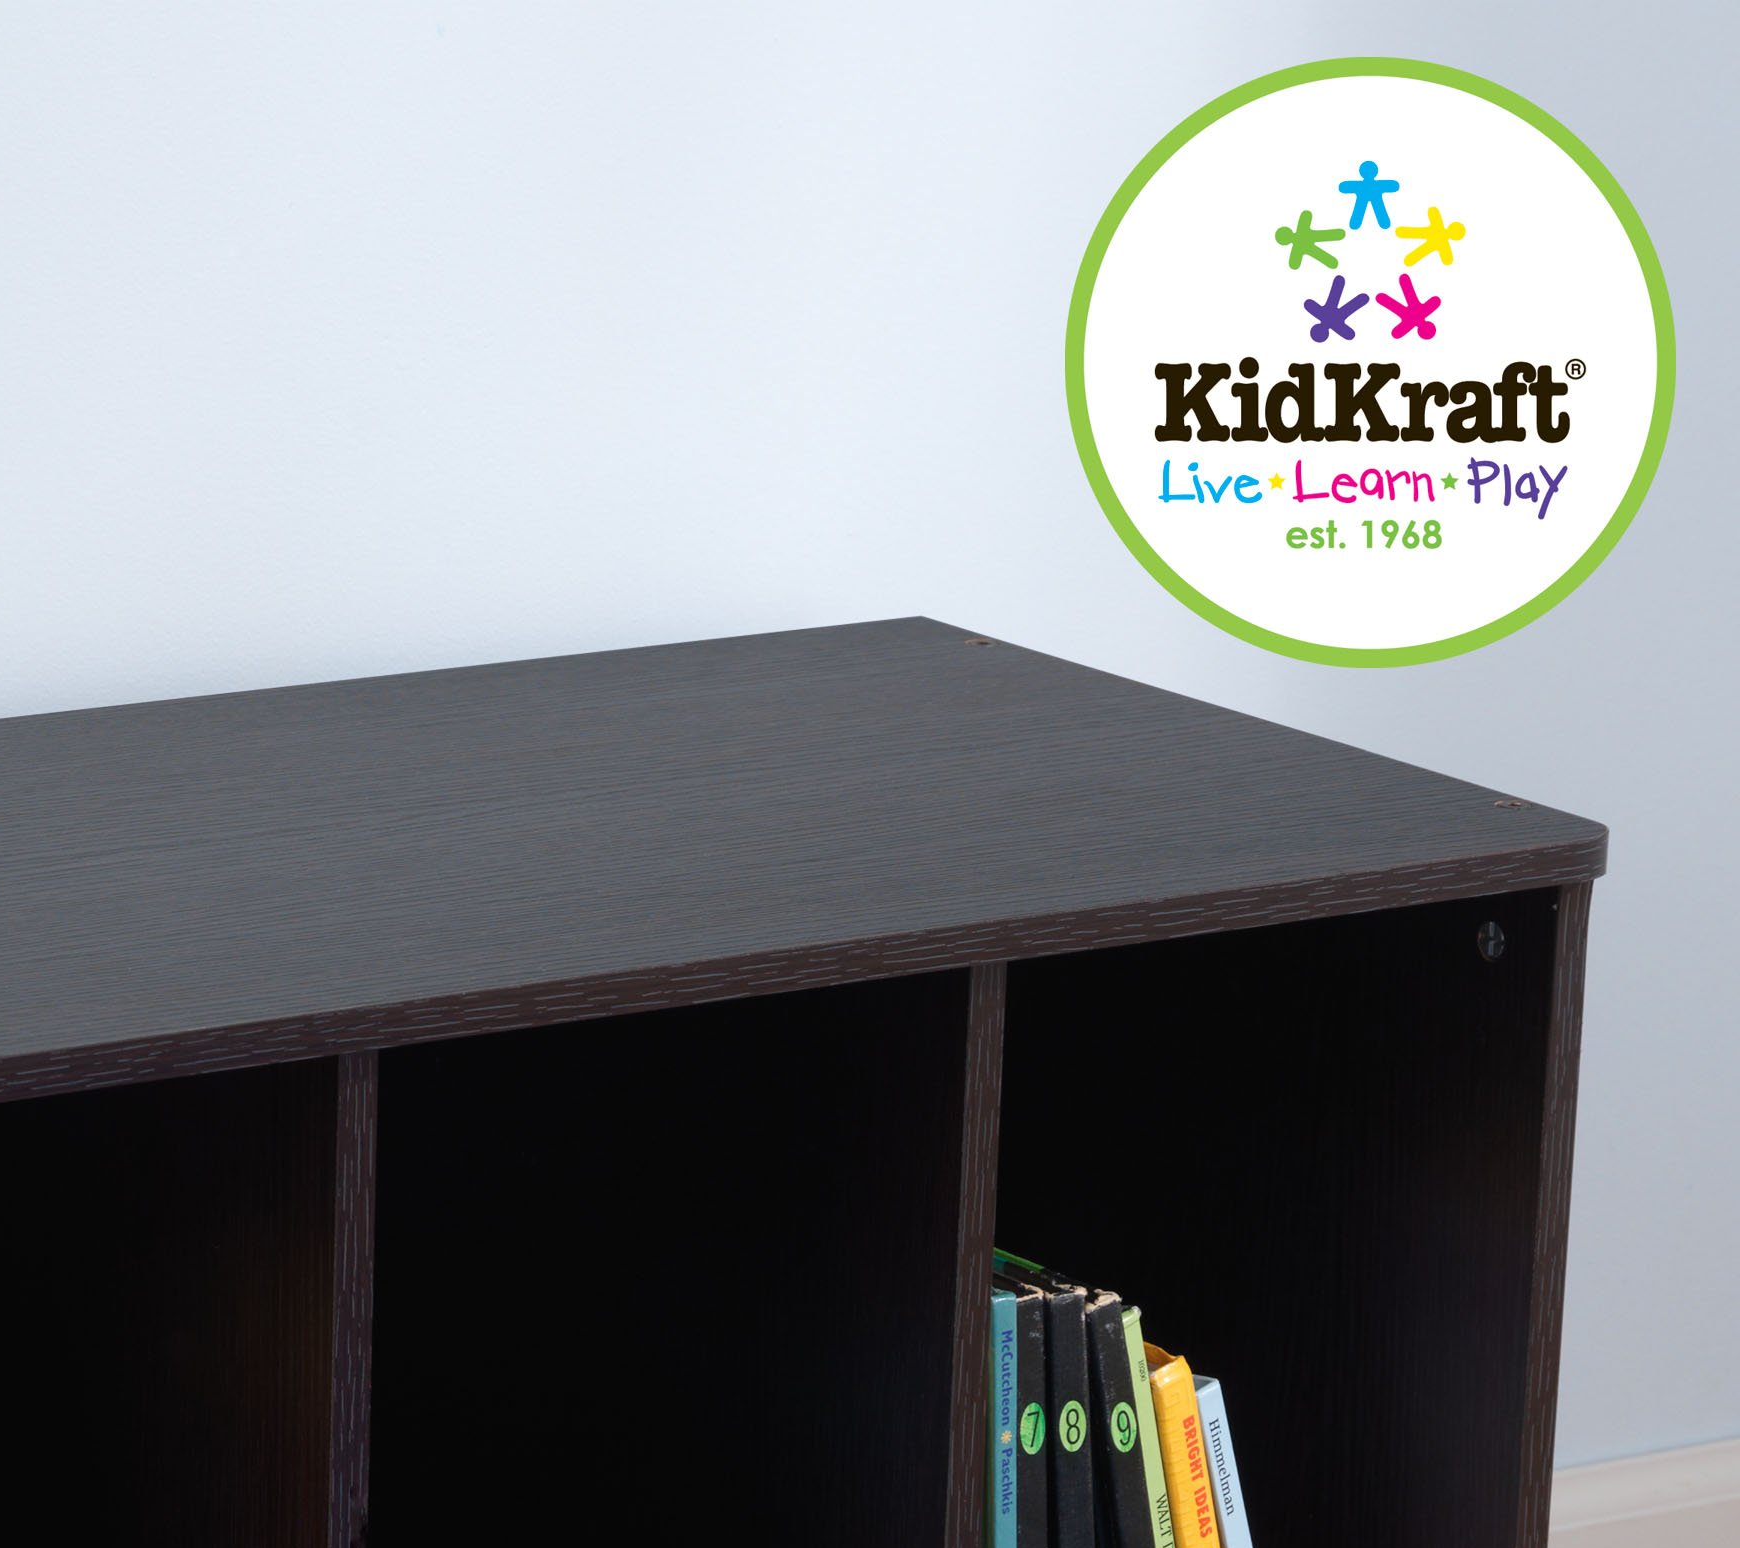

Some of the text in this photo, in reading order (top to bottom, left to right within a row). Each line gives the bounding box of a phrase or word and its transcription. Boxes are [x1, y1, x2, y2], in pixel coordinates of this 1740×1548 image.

[1001, 1330, 1013, 1515] McCutcheon Paschkis
[1027, 1411, 1040, 1448] 7
[1066, 1408, 1081, 1445] 8
[1116, 1410, 1132, 1446] 9
[1182, 1414, 1213, 1538] BRIGHT IDEAS
[1208, 1418, 1235, 1516] Himmelman
[1156, 1493, 1172, 1537] WALT
